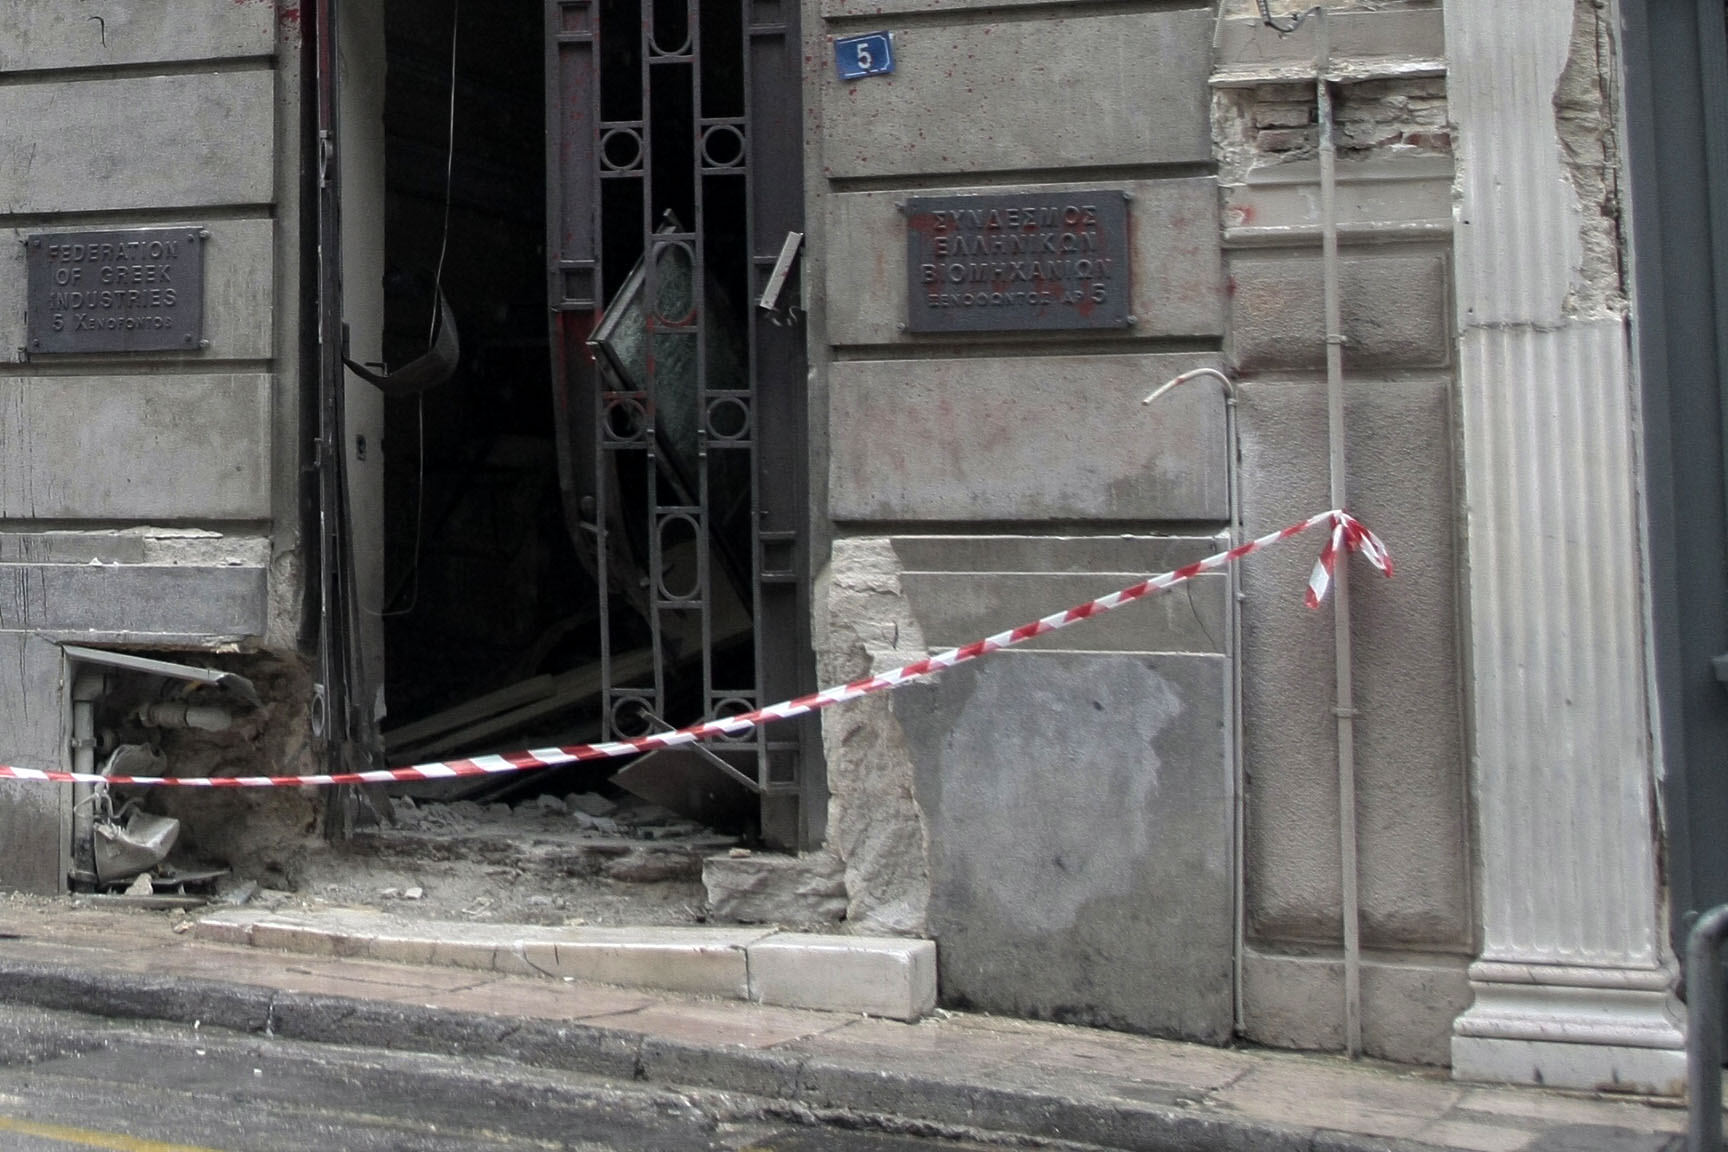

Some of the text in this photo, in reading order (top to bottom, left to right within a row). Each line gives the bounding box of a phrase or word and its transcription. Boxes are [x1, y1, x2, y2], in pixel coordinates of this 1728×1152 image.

[857, 43, 872, 68] 5
[931, 205, 1097, 232] ΣΥΝΔΕΣΜΟΣ
[48, 240, 179, 264] FEDERATION
[934, 231, 1097, 258] ΕΛΛΗΝΙΚΩΝ
[55, 264, 172, 286] OF GREEK
[921, 259, 1112, 285] ΒΙΟΜΗΧΑΝΙΩΝ
[49, 288, 178, 311] INDUSTRIES
[1091, 283, 1106, 305] 5
[52, 313, 65, 332] 5
